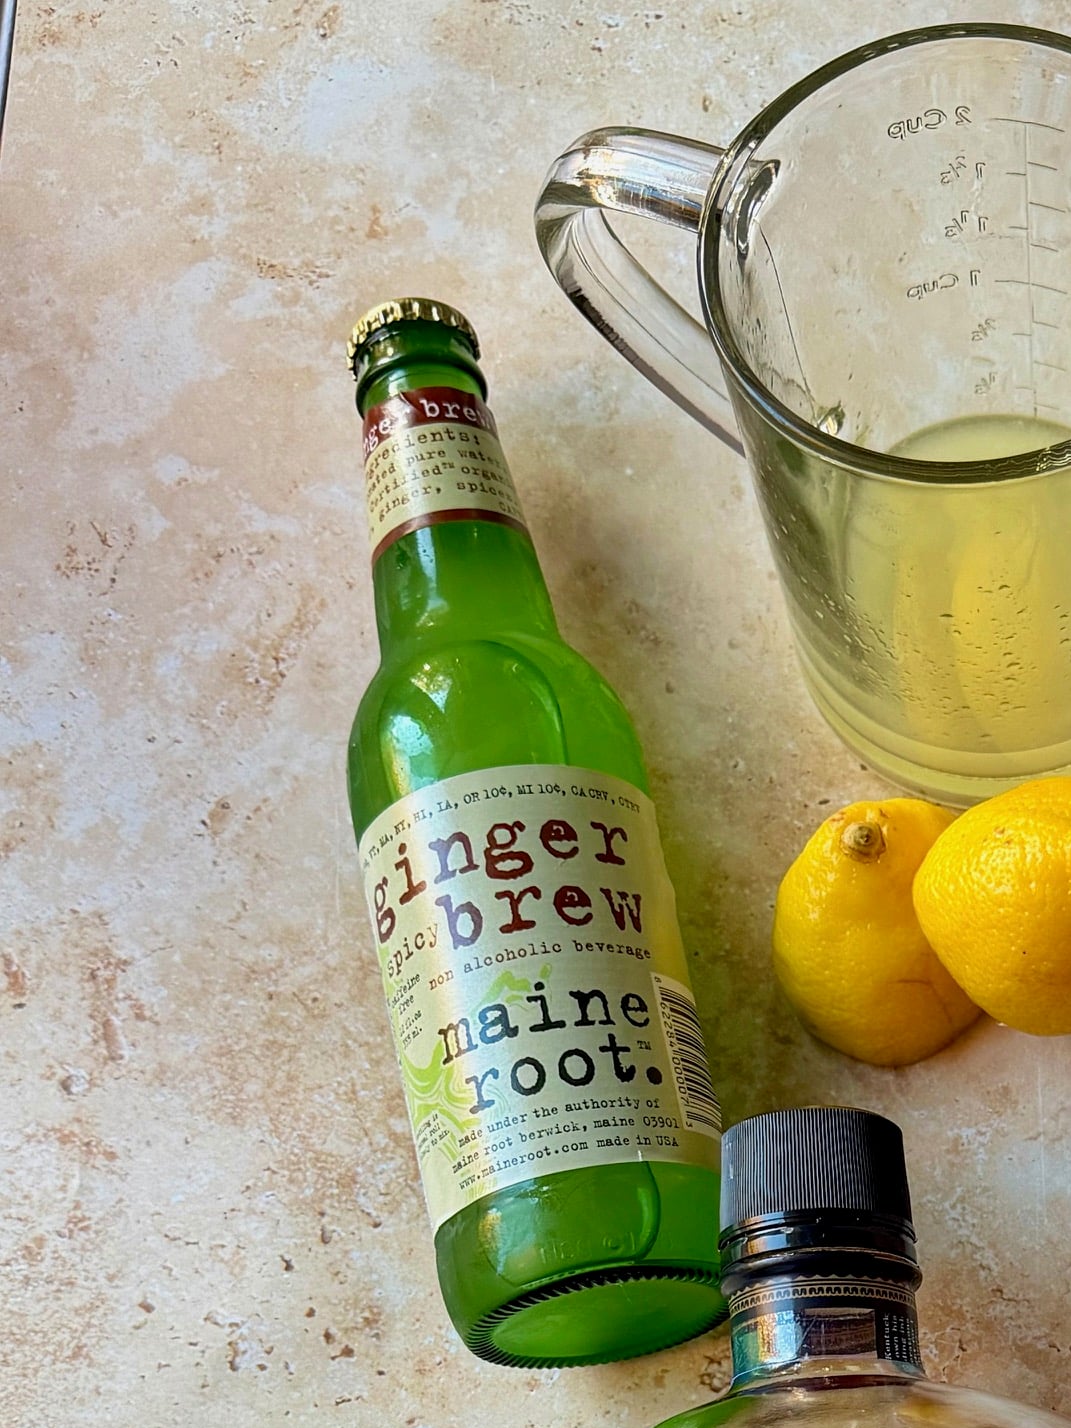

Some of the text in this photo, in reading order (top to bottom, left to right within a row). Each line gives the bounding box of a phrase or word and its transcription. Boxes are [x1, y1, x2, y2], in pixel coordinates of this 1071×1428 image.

[406, 449, 447, 467] pure
[464, 792, 480, 805] OR
[517, 784, 534, 795] MI
[539, 783, 566, 797] 10¢,
[374, 819, 628, 944] ginger
[387, 885, 643, 978] spicy brew
[428, 970, 454, 991] non
[463, 942, 562, 974] alcoholic
[573, 939, 651, 960] beverage
[438, 981, 650, 1065] maine
[465, 1033, 662, 1115] root.
[672, 1056, 690, 1105] 00007
[452, 1151, 479, 1174] maine
[484, 1136, 513, 1156] root
[519, 1121, 587, 1143] berwick,
[594, 1116, 635, 1129] maine
[643, 1116, 680, 1129] 03901
[458, 1128, 483, 1148] made
[487, 1112, 527, 1133] under
[533, 1106, 559, 1118] the
[565, 1097, 640, 1113] authority
[646, 1098, 660, 1108] of
[460, 1135, 679, 1190] www.maineroot.com made in USA
